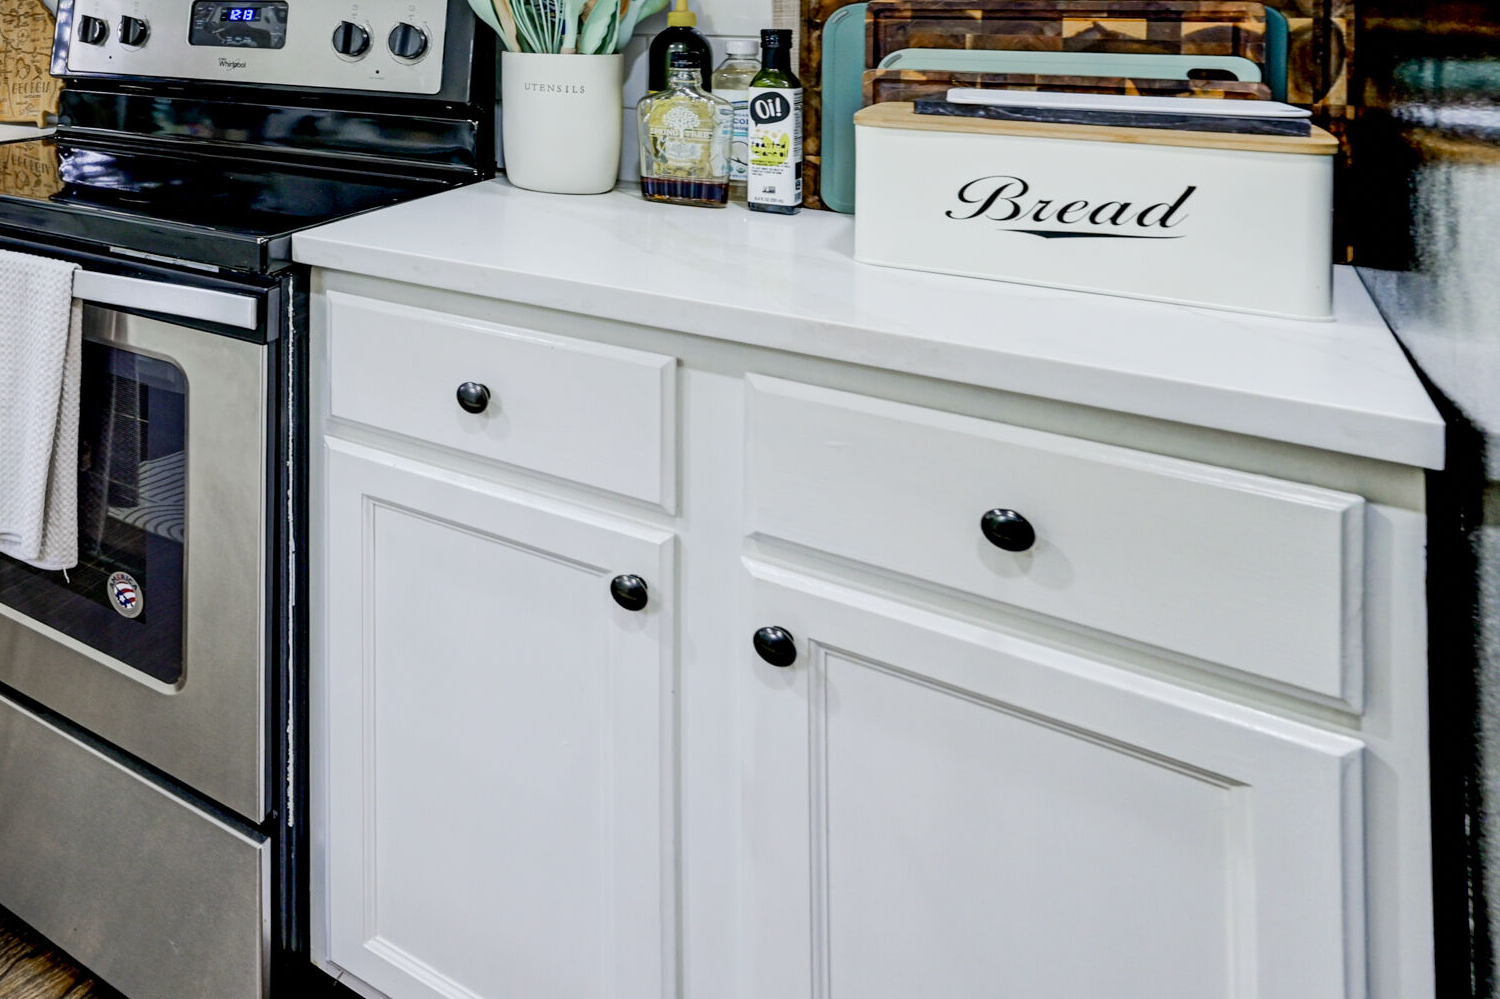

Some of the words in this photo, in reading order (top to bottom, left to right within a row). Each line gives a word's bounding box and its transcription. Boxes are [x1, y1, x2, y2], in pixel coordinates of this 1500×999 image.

[229, 9, 254, 21] 12:13
[524, 82, 587, 94] UTENSILS
[754, 97, 783, 119] Oi!
[944, 174, 1197, 229] Bread
